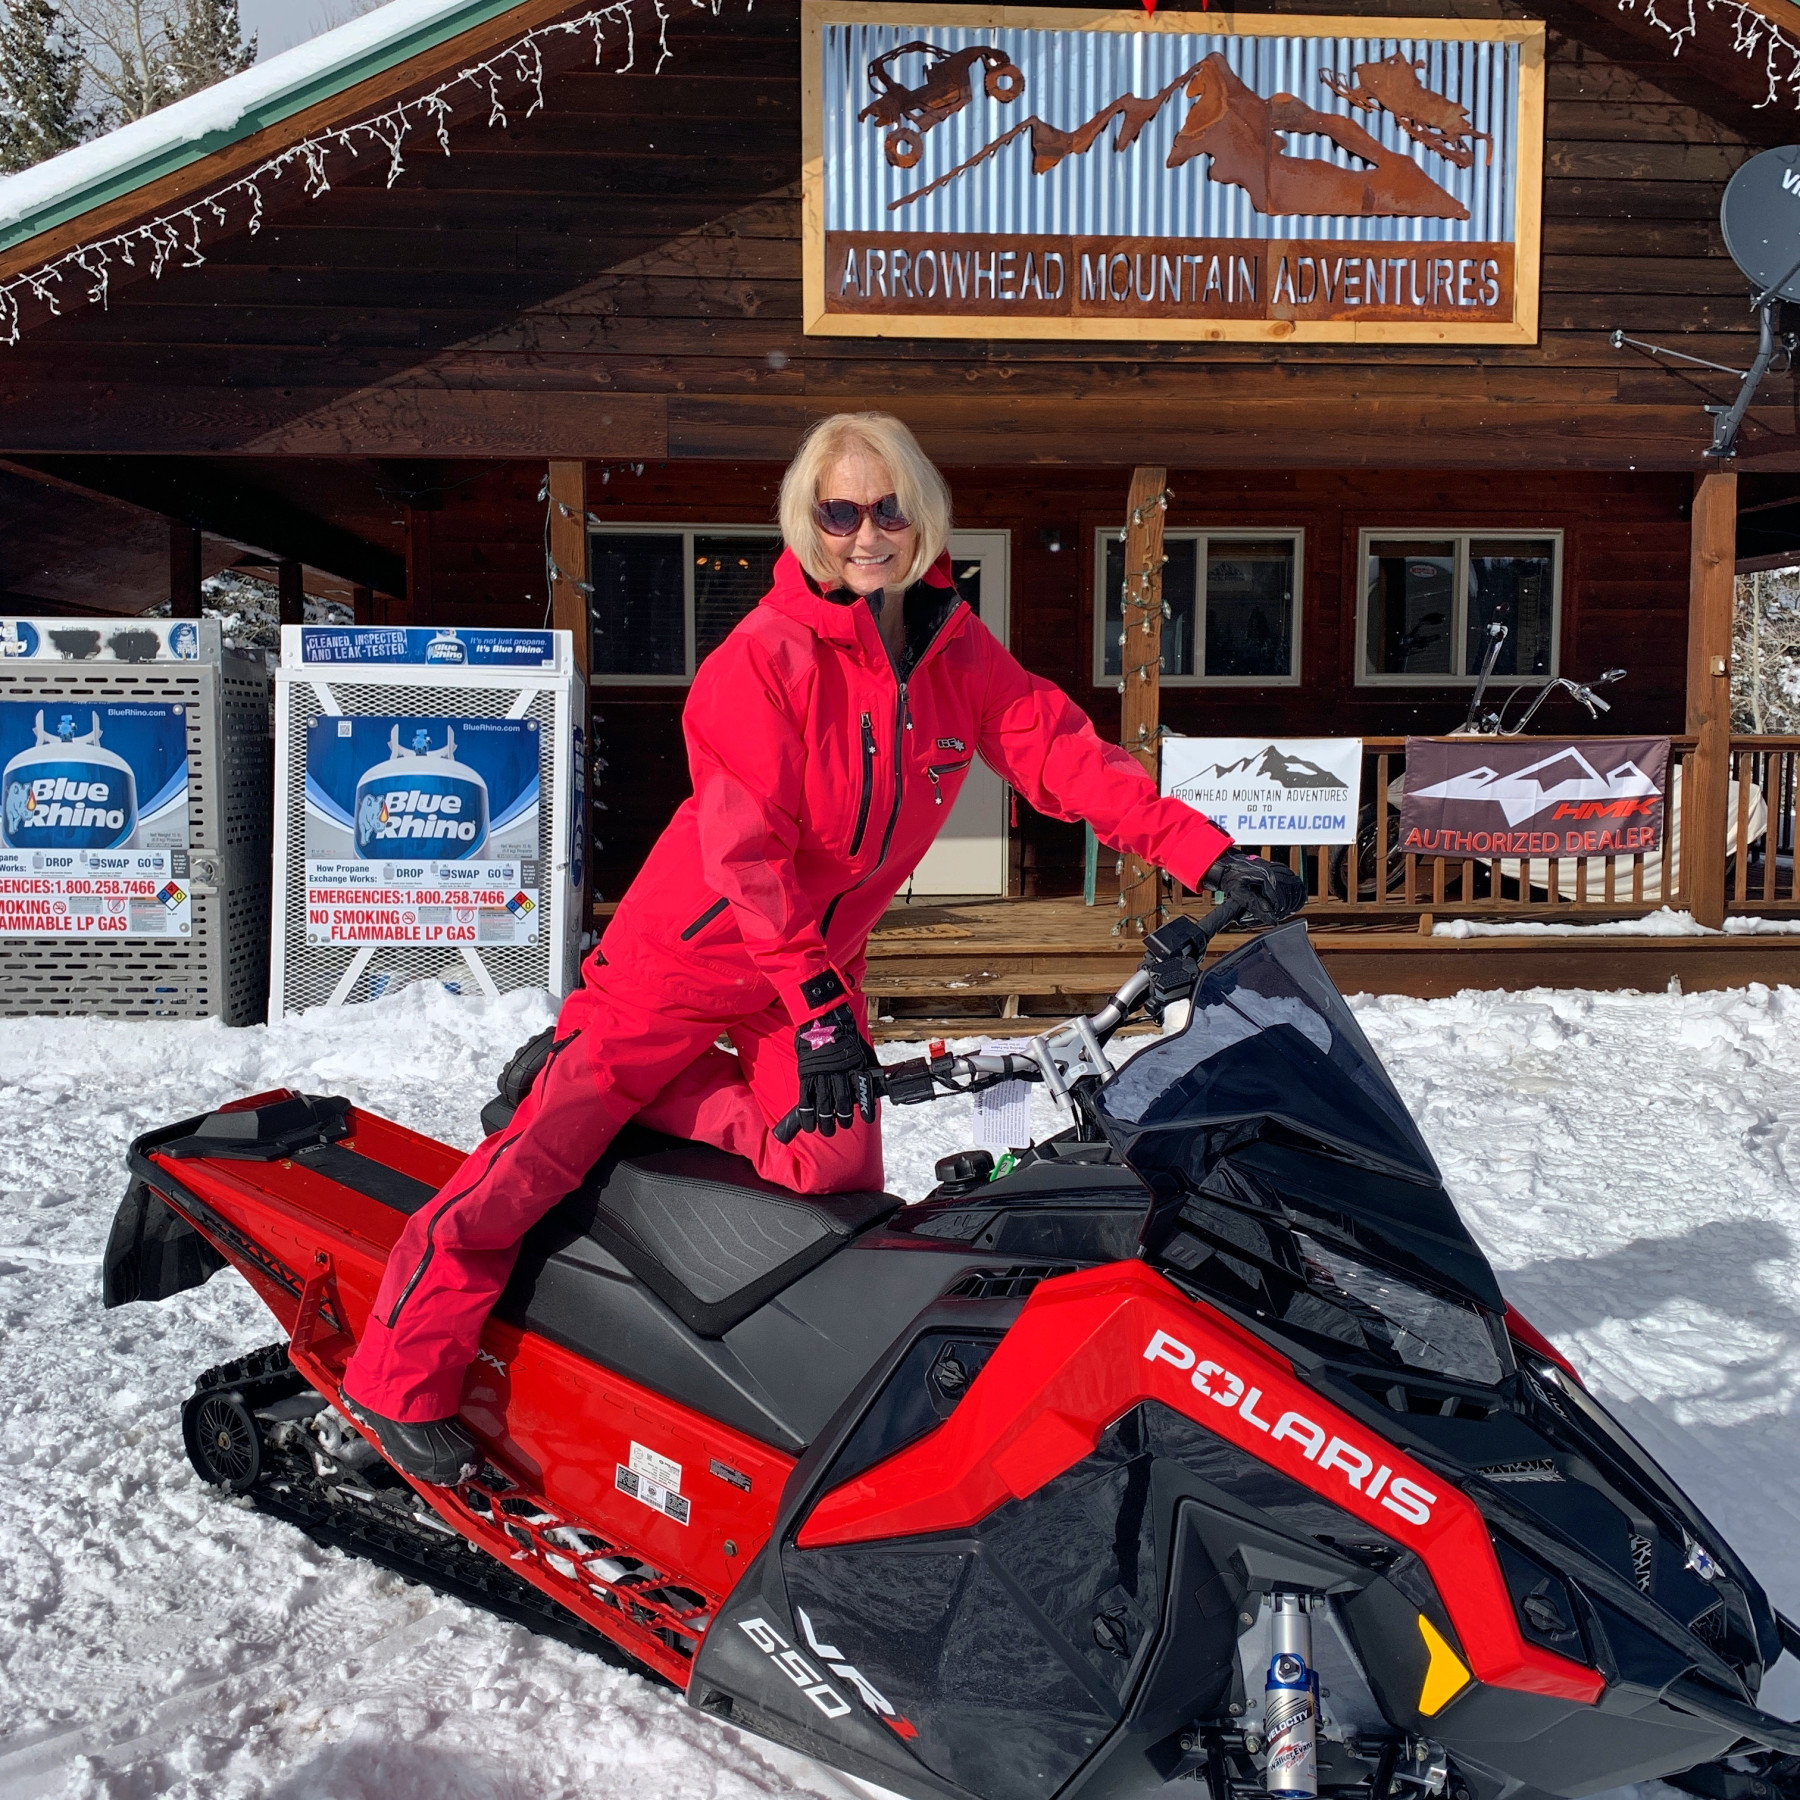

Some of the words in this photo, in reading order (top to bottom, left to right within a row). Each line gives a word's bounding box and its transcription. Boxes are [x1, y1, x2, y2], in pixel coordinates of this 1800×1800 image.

[840, 248, 1065, 299] ARROWHEAD
[1081, 253, 1257, 303] MOUNTAIN
[1272, 256, 1500, 306] ADVENTURES
[476, 645, 490, 653] It's
[492, 644, 513, 653] Blue
[498, 638, 512, 646] just
[513, 638, 547, 647] propane.
[312, 648, 331, 661] AND
[335, 643, 407, 659] LEAK-TESTED.
[108, 708, 166, 717] BlueRhino.com
[463, 723, 521, 732] BlueRhino.com
[32, 777, 109, 802] Blue
[1170, 788, 1228, 802] ARROWHEAD
[1232, 789, 1282, 802] MOUNTAIN
[1286, 789, 1348, 802] ADVENTURES
[384, 790, 462, 814] Blue
[1247, 804, 1258, 812] GO
[1263, 804, 1273, 812] TO
[24, 802, 124, 829] Rhino
[1552, 797, 1661, 821] HMK
[375, 814, 476, 841] Rhino
[1238, 815, 1346, 830] PLATEAU.COM
[1405, 827, 1560, 853] AUTHORIZED
[1566, 826, 1655, 851] DEALER
[45, 857, 73, 867] DROP
[101, 858, 129, 869] SWAP
[137, 857, 151, 868] GO
[316, 865, 333, 873] How
[336, 864, 369, 876] Propane
[396, 869, 424, 878] DROP
[451, 869, 480, 880] SWAP
[487, 869, 501, 878] GO
[309, 874, 347, 884] Exchange
[350, 874, 378, 883] Works:
[161, 892, 167, 900] 2
[176, 892, 182, 900] 0
[510, 902, 516, 910] 2
[525, 901, 531, 909] 0
[77, 917, 94, 931] LP
[98, 917, 127, 931] GAS
[309, 910, 329, 924] NO
[333, 910, 400, 925] SMOKING
[331, 926, 420, 940] FLAMMABLE
[425, 926, 443, 940] LP
[446, 926, 476, 940] GAS
[858, 1075, 869, 1115] HMK
[1142, 1329, 1437, 1526] POLARIS
[738, 1617, 851, 1720] 650
[1267, 1709, 1309, 1743] VELOCITY
